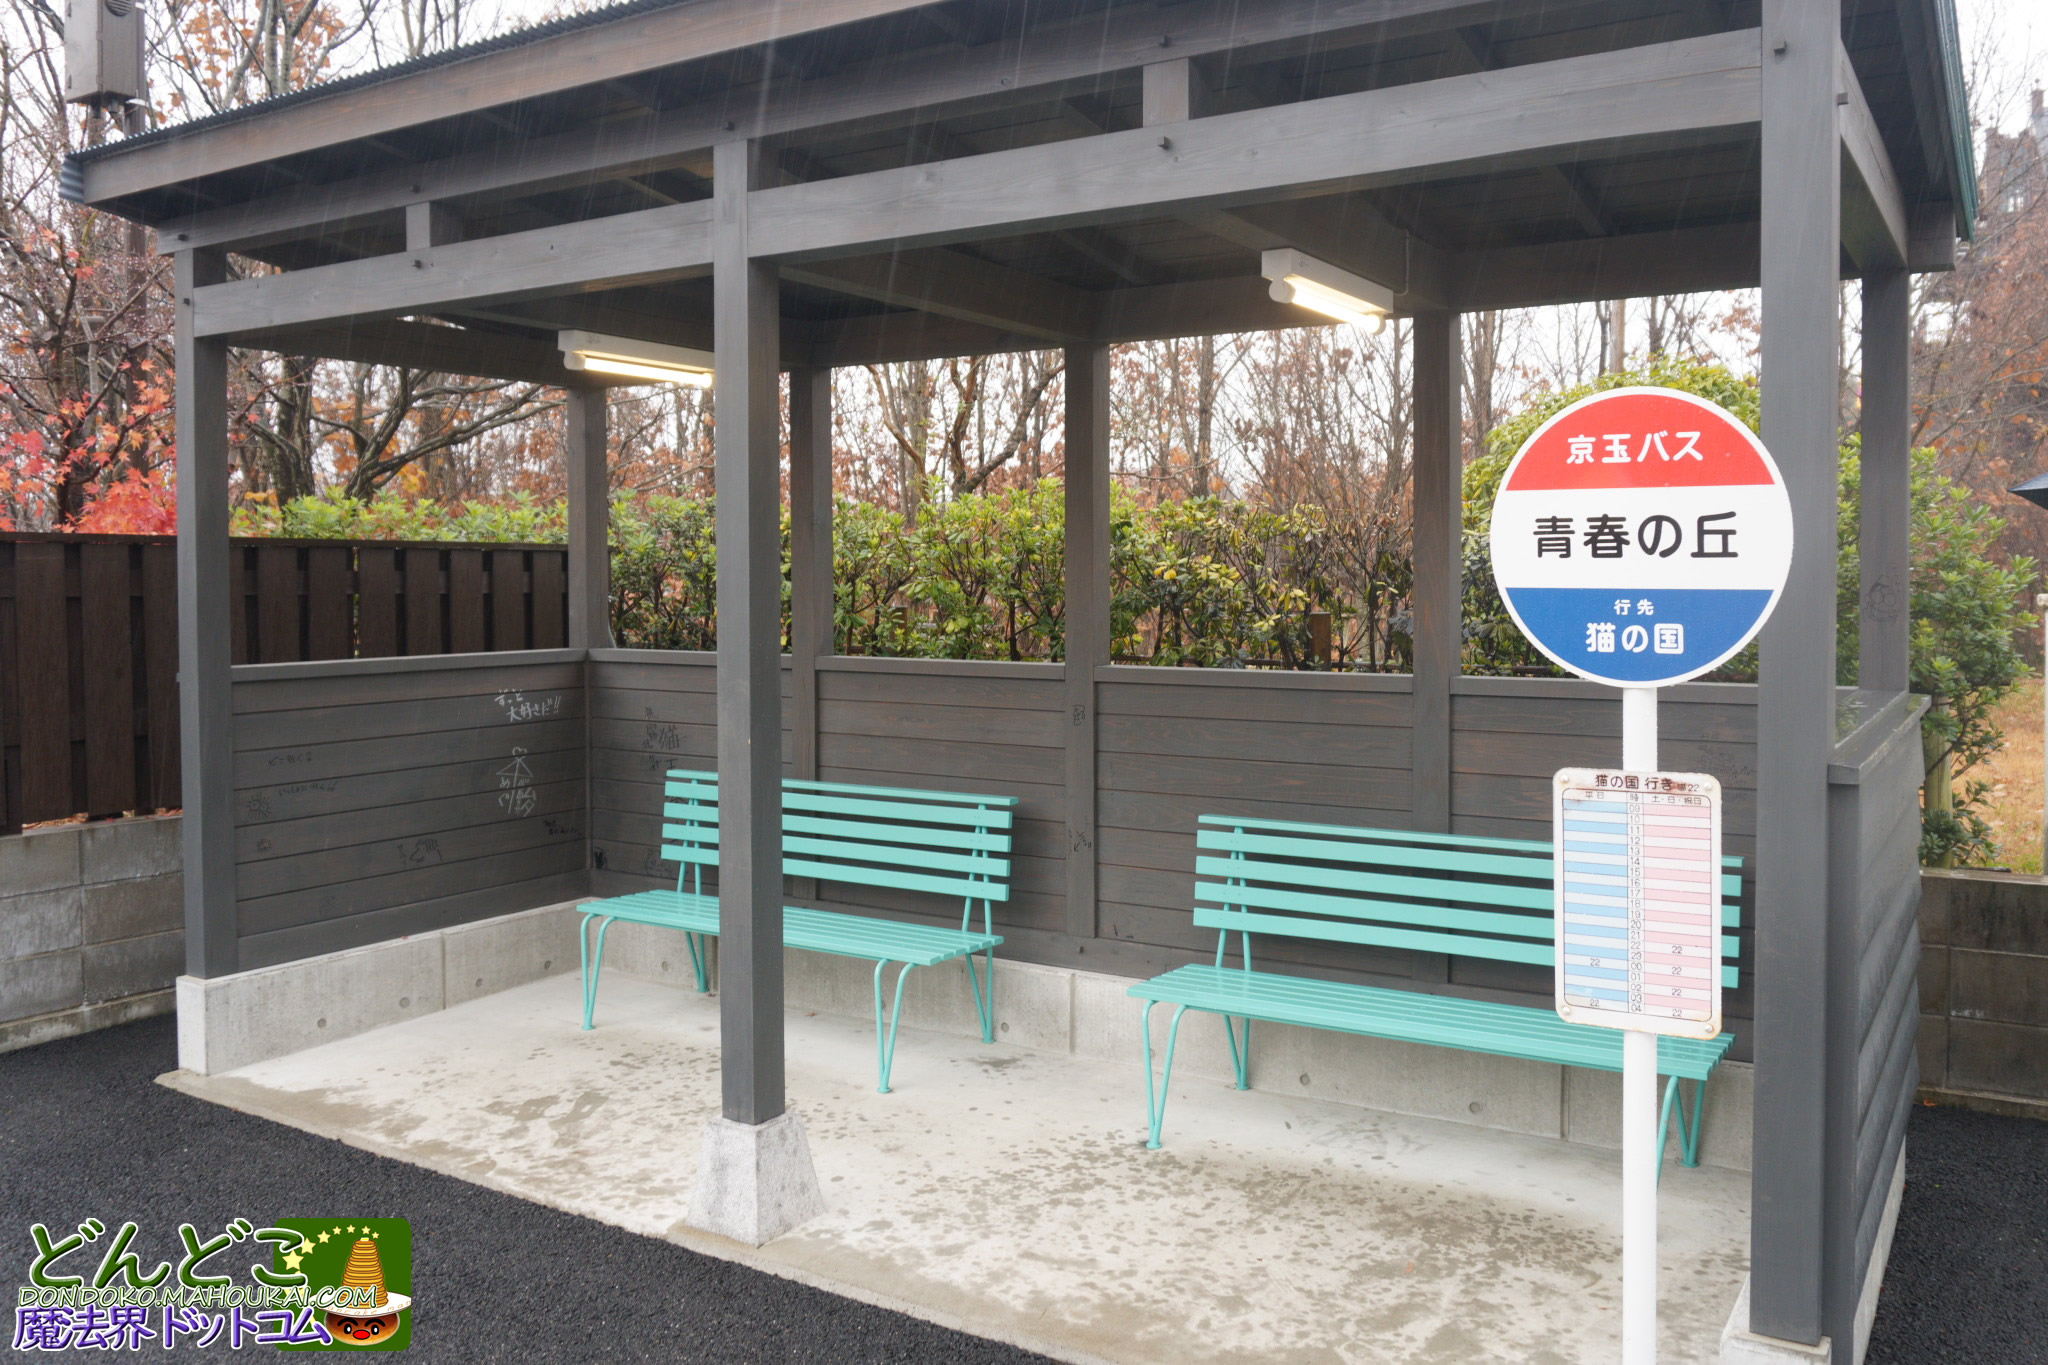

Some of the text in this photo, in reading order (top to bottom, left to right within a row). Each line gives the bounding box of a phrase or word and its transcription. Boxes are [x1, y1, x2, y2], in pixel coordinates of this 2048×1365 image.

[1566, 430, 1703, 464] 京玉バス
[1533, 511, 1739, 558] 青春の丘
[1613, 599, 1654, 616] 行先
[1585, 622, 1684, 655] 猫の国
[1595, 774, 1639, 789] 猫の国
[1630, 815, 1640, 824] 10
[1630, 826, 1640, 834] 11
[1630, 836, 1640, 845] 12
[1630, 847, 1640, 856] 13
[1630, 857, 1640, 866] 14
[1630, 868, 1640, 876] 15
[1630, 878, 1640, 886] 16
[1630, 888, 1640, 896] 17
[1630, 899, 1640, 908] 18
[1630, 910, 1640, 918] 19
[1631, 921, 1642, 929] 20
[1631, 931, 1640, 939] 21
[1631, 942, 1641, 950] 22
[1672, 946, 1683, 954] 22
[1631, 952, 1642, 960] 23
[1590, 958, 1600, 966] 22
[1631, 962, 1642, 970] 00
[1631, 973, 1641, 981] 01
[1672, 988, 1682, 996] 22
[1631, 994, 1642, 1002] 03
[1590, 999, 1600, 1007] 22
[1631, 1004, 1642, 1012] 04
[1672, 1009, 1682, 1017] 22
